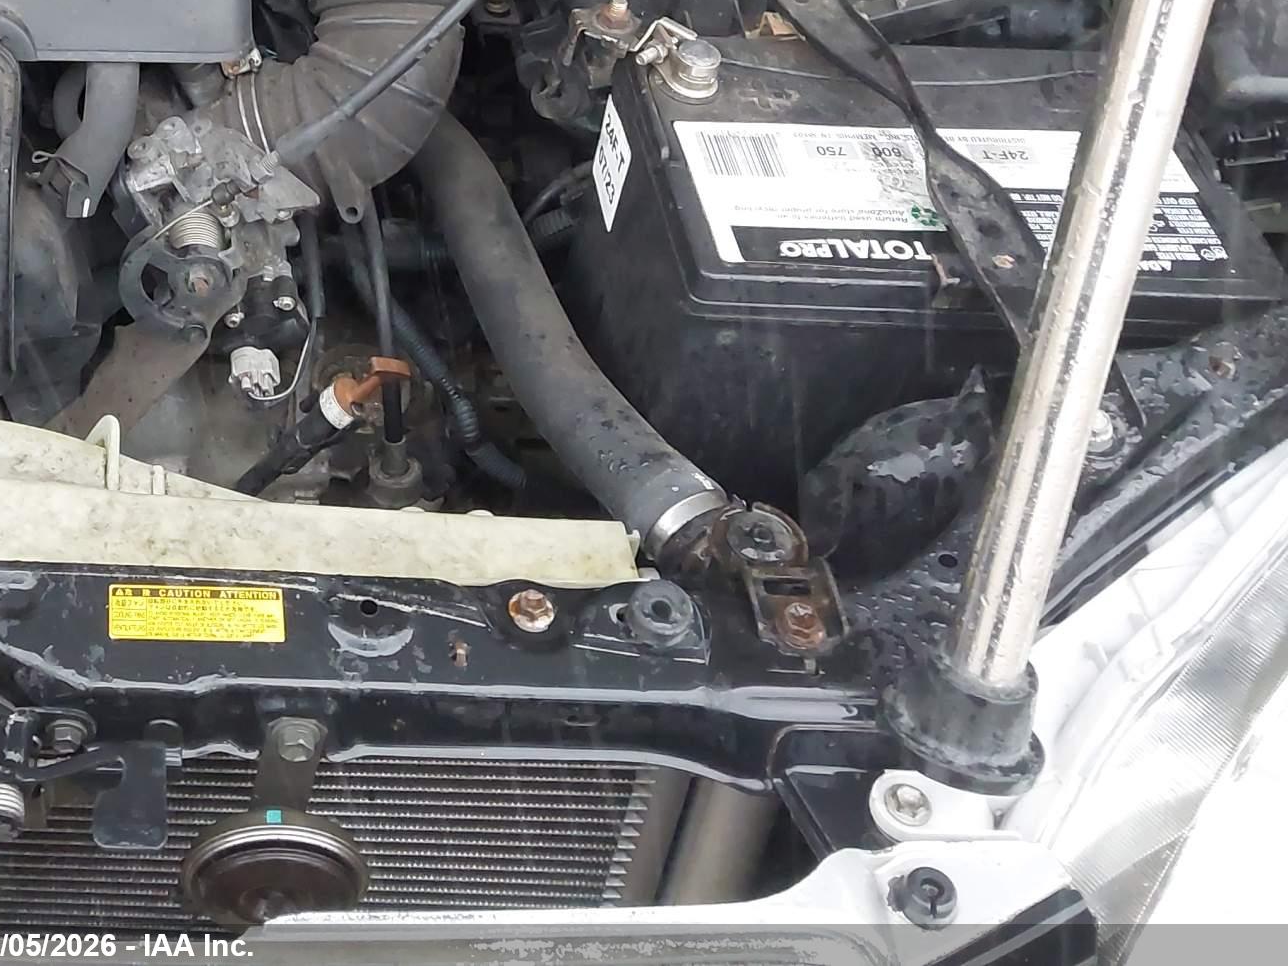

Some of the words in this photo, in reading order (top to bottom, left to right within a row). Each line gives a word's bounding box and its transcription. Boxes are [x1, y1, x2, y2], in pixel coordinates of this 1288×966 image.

[816, 145, 847, 156] 750
[872, 146, 903, 157] 600
[983, 150, 1029, 161] 24F-T
[780, 238, 933, 260] TOTALPRO
[159, 590, 211, 598] CAUTION
[219, 590, 277, 600] ATTENTION
